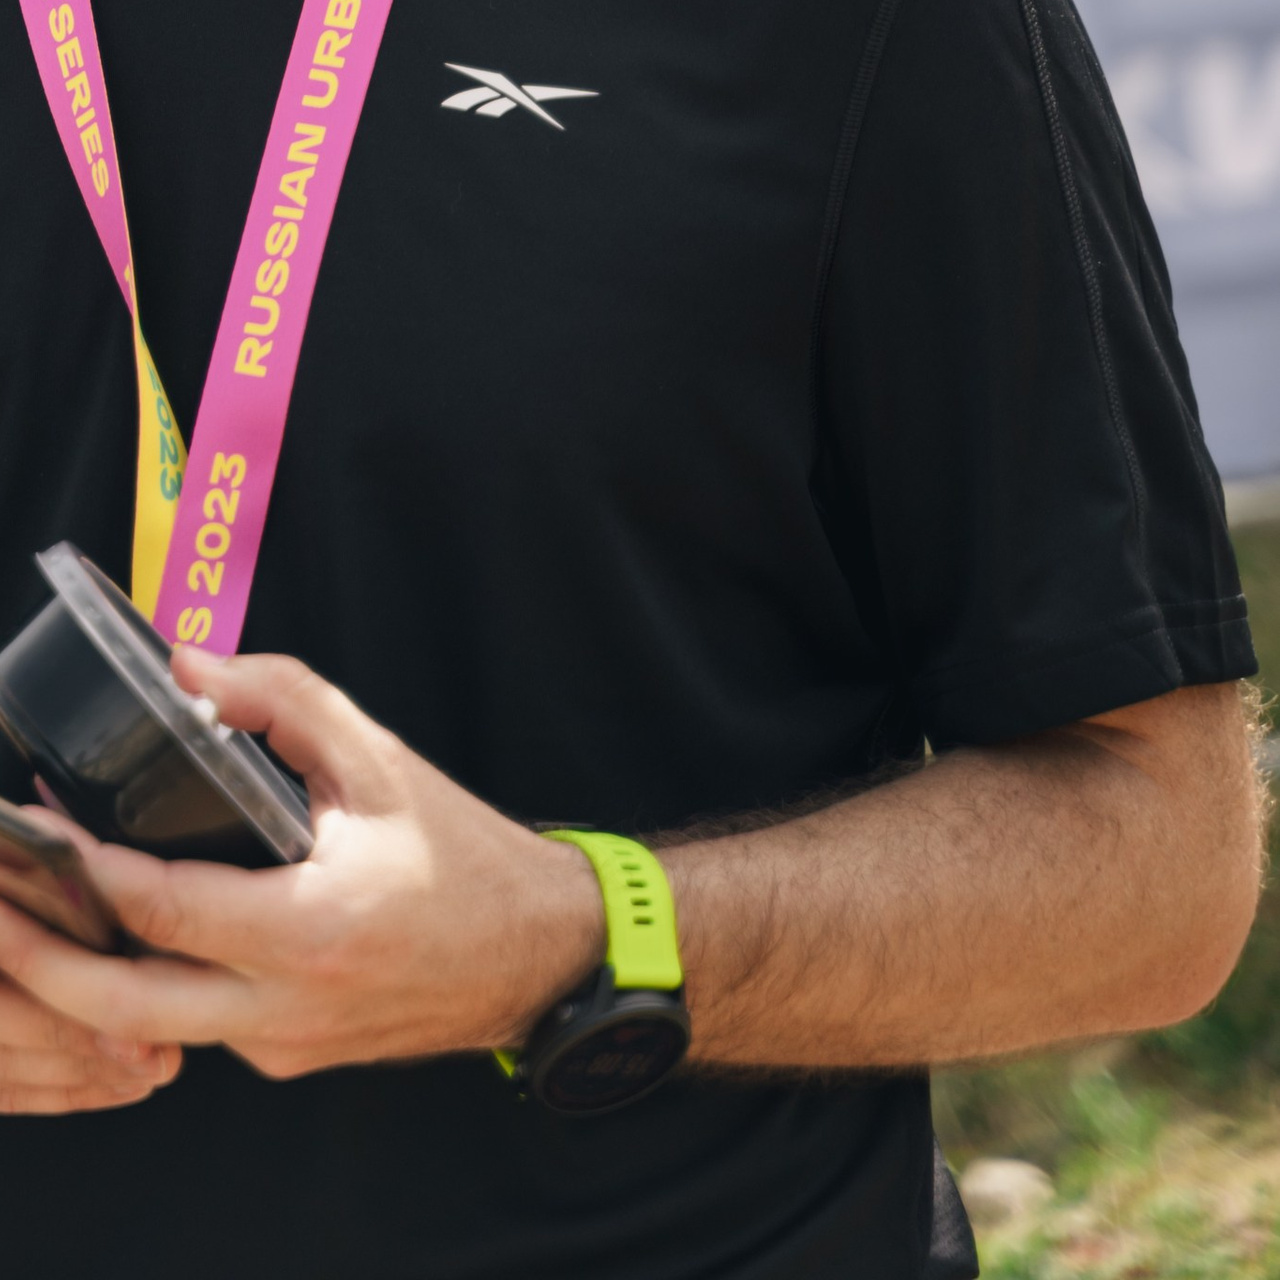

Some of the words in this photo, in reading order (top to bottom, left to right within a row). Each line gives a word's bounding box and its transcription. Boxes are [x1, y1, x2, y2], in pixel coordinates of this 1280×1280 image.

[48, 4, 110, 197] SERIES
[234, 123, 326, 378] RUSSIAN
[187, 452, 247, 597] 2023
